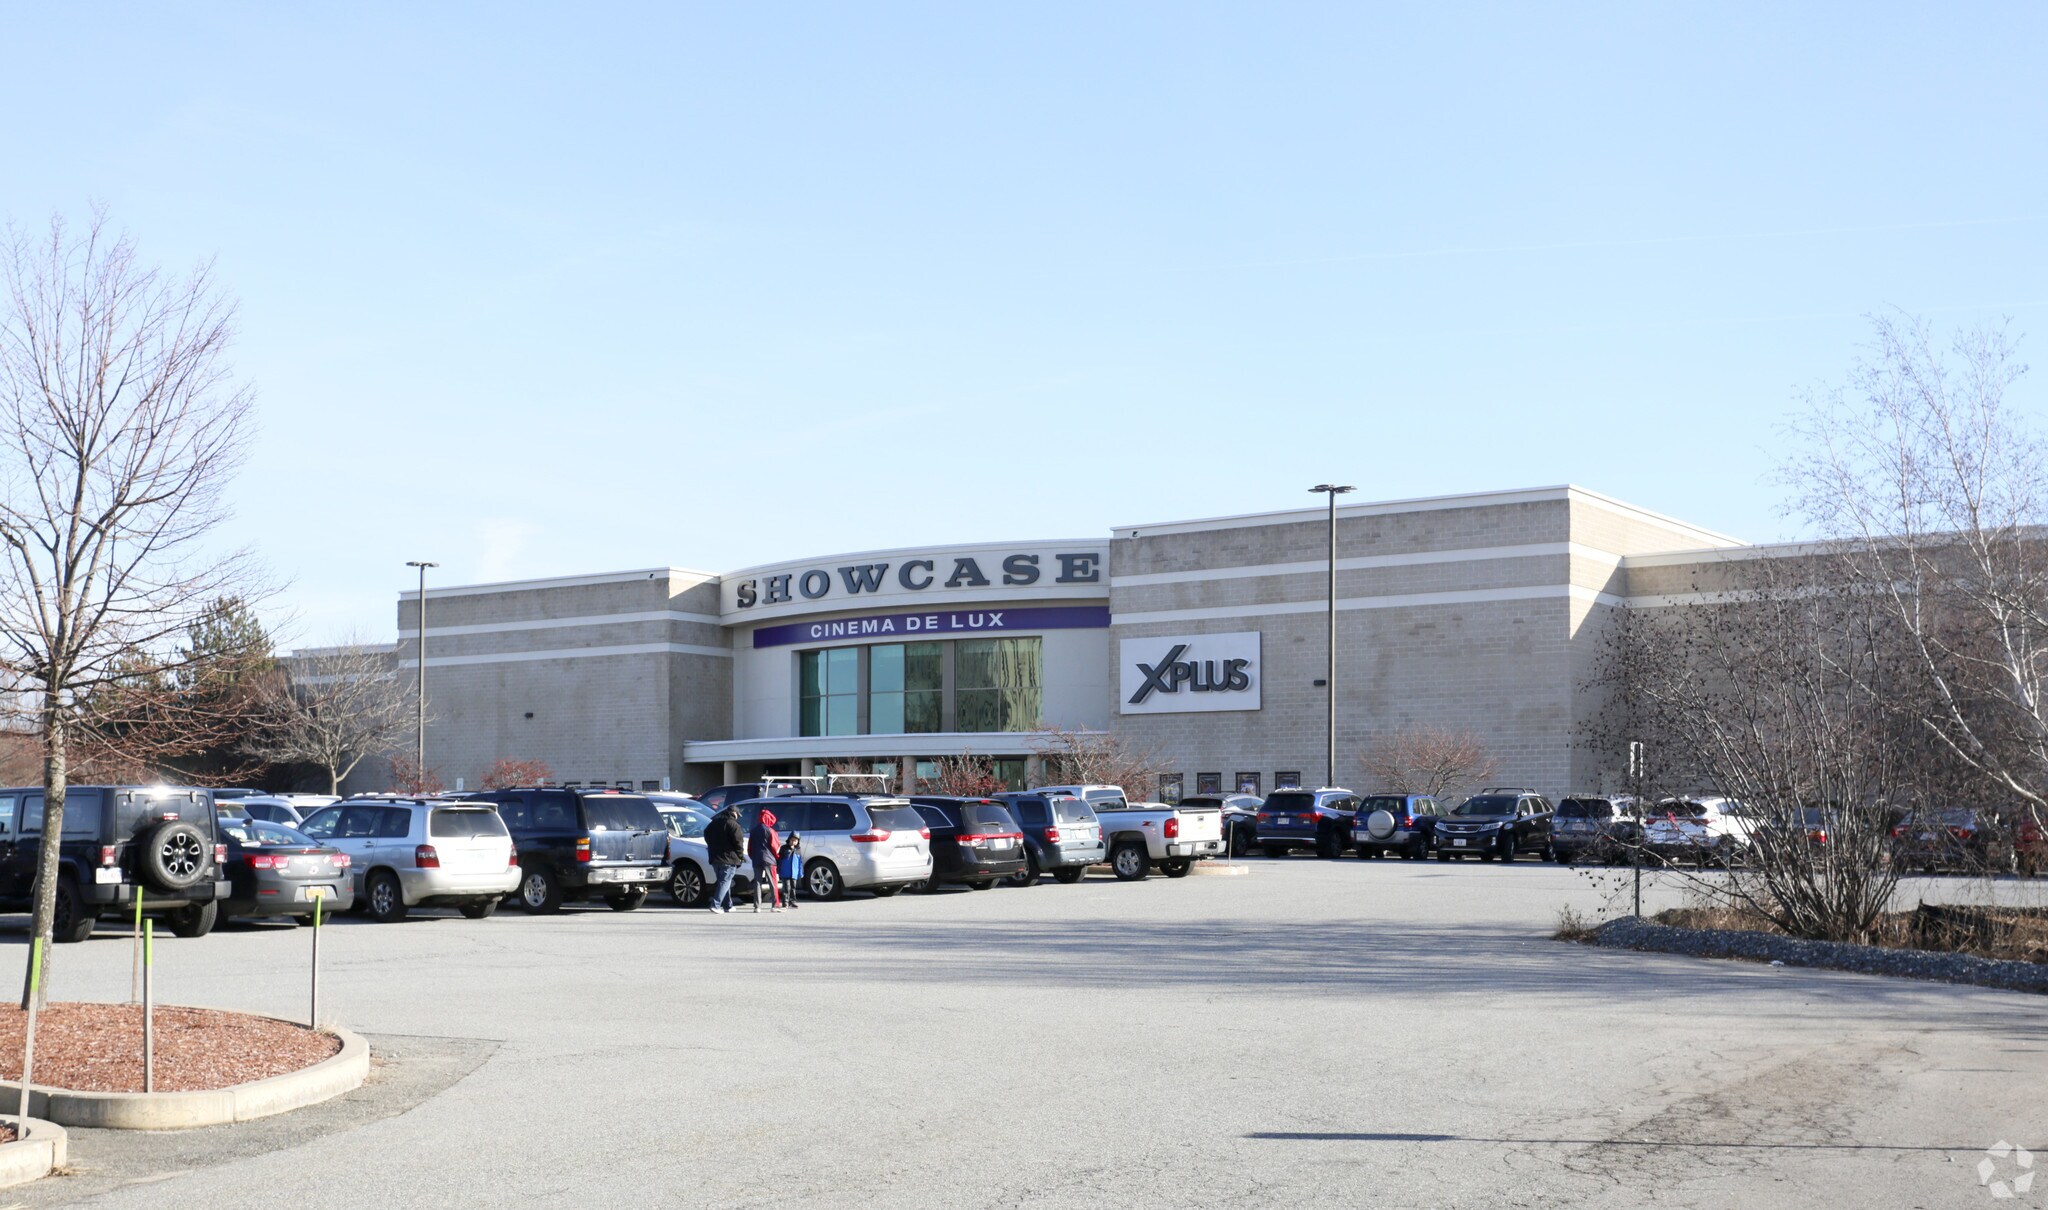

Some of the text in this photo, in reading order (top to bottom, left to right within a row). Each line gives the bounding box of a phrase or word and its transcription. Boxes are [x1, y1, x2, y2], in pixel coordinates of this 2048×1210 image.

[736, 552, 1101, 609] SHOWCASE
[810, 612, 1004, 638] CINEMA DE LUX
